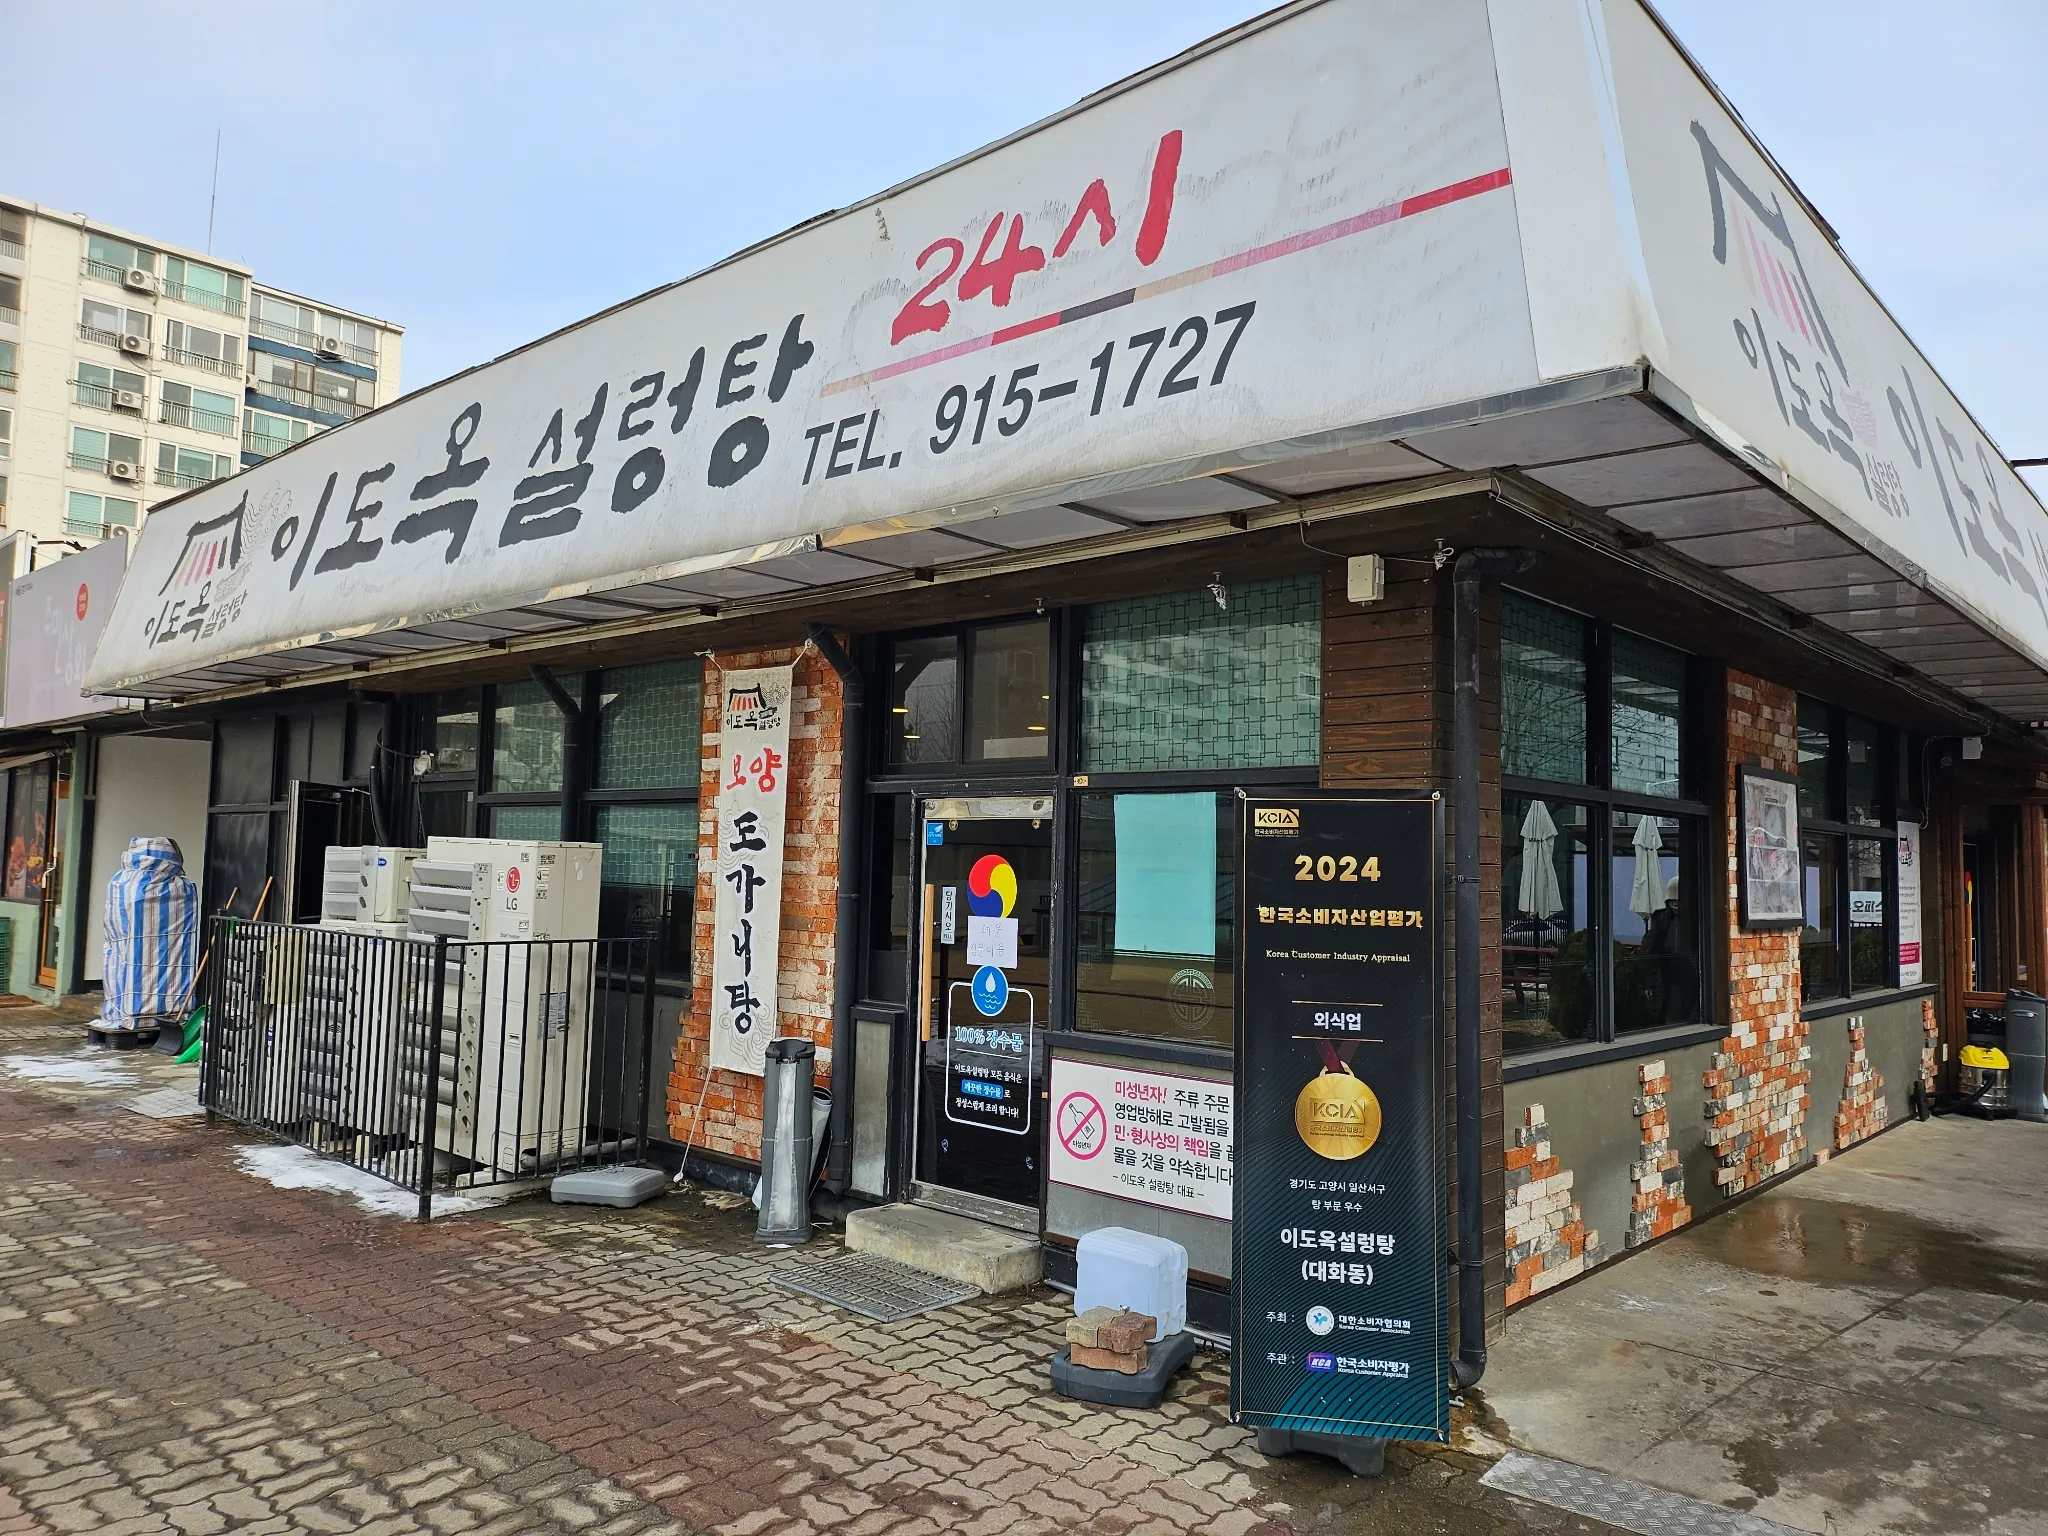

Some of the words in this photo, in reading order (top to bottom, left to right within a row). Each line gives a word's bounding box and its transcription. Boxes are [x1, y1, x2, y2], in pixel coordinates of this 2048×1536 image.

[891, 129, 1182, 346] 24시
[802, 409, 902, 485] TEL.
[929, 301, 1256, 455] 915-1727
[1733, 307, 1872, 502] 이도옥
[1865, 453, 1909, 518] 설렁탕
[145, 580, 212, 649] 이도옥
[201, 589, 248, 639] 설렁탕
[726, 711, 758, 731] 이도옥
[759, 717, 781, 730] 설렁탕
[727, 747, 783, 792] 보양
[1258, 812, 1293, 824] KCIA
[1294, 855, 1381, 882] 2024
[506, 897, 518, 910] LG
[1258, 906, 1423, 928] 한국소비자산업평가
[1266, 950, 1289, 958] Korea
[1291, 950, 1331, 960] Customer
[1333, 952, 1368, 963] Industry
[1371, 953, 1410, 963] Appraisal
[1313, 1012, 1362, 1031] 외식업
[955, 1026, 985, 1044] 100%
[986, 1030, 1024, 1052] 정수물
[954, 1064, 989, 1078] 이도옥설렁탕
[990, 1070, 1002, 1080] 모든
[1004, 1072, 1022, 1083] 음식은
[964, 1082, 982, 1095] 깨끗한
[983, 1086, 1001, 1097] 정수물
[1004, 1090, 1011, 1098] 로
[1115, 1081, 1167, 1104] 미성년자!
[1174, 1090, 1199, 1109] 주류
[1204, 1094, 1230, 1114] 주문
[955, 1097, 984, 1111] 정성스럽게
[985, 1103, 998, 1114] 조리
[999, 1105, 1019, 1118] 합니다!
[1313, 1102, 1360, 1120] KCIA
[1114, 1102, 1174, 1126] 영업방해로
[1177, 1114, 1229, 1137] 고발됨을
[1184, 1137, 1222, 1160] 책임을
[1114, 1147, 1137, 1166] 물을
[1141, 1152, 1165, 1172] 것을
[1121, 1173, 1146, 1188] 이도옥
[1148, 1179, 1174, 1195] 설렁탕
[1177, 1185, 1195, 1198] 대표
[1289, 1179, 1317, 1190] 경기도
[1319, 1181, 1346, 1192] 고양시
[1348, 1182, 1386, 1195] 일산서구
[1311, 1200, 1321, 1210] 탕
[1323, 1201, 1341, 1212] 부문
[1344, 1202, 1363, 1213] 우수
[1280, 1227, 1396, 1256] 이도옥설렁탕
[1301, 1259, 1374, 1286] (대화동)
[1265, 1312, 1287, 1323] 주최
[1338, 1315, 1411, 1330] 대한소비자협의회
[1266, 1353, 1287, 1365] 주관
[1336, 1356, 1410, 1373] 한국소비자평가
